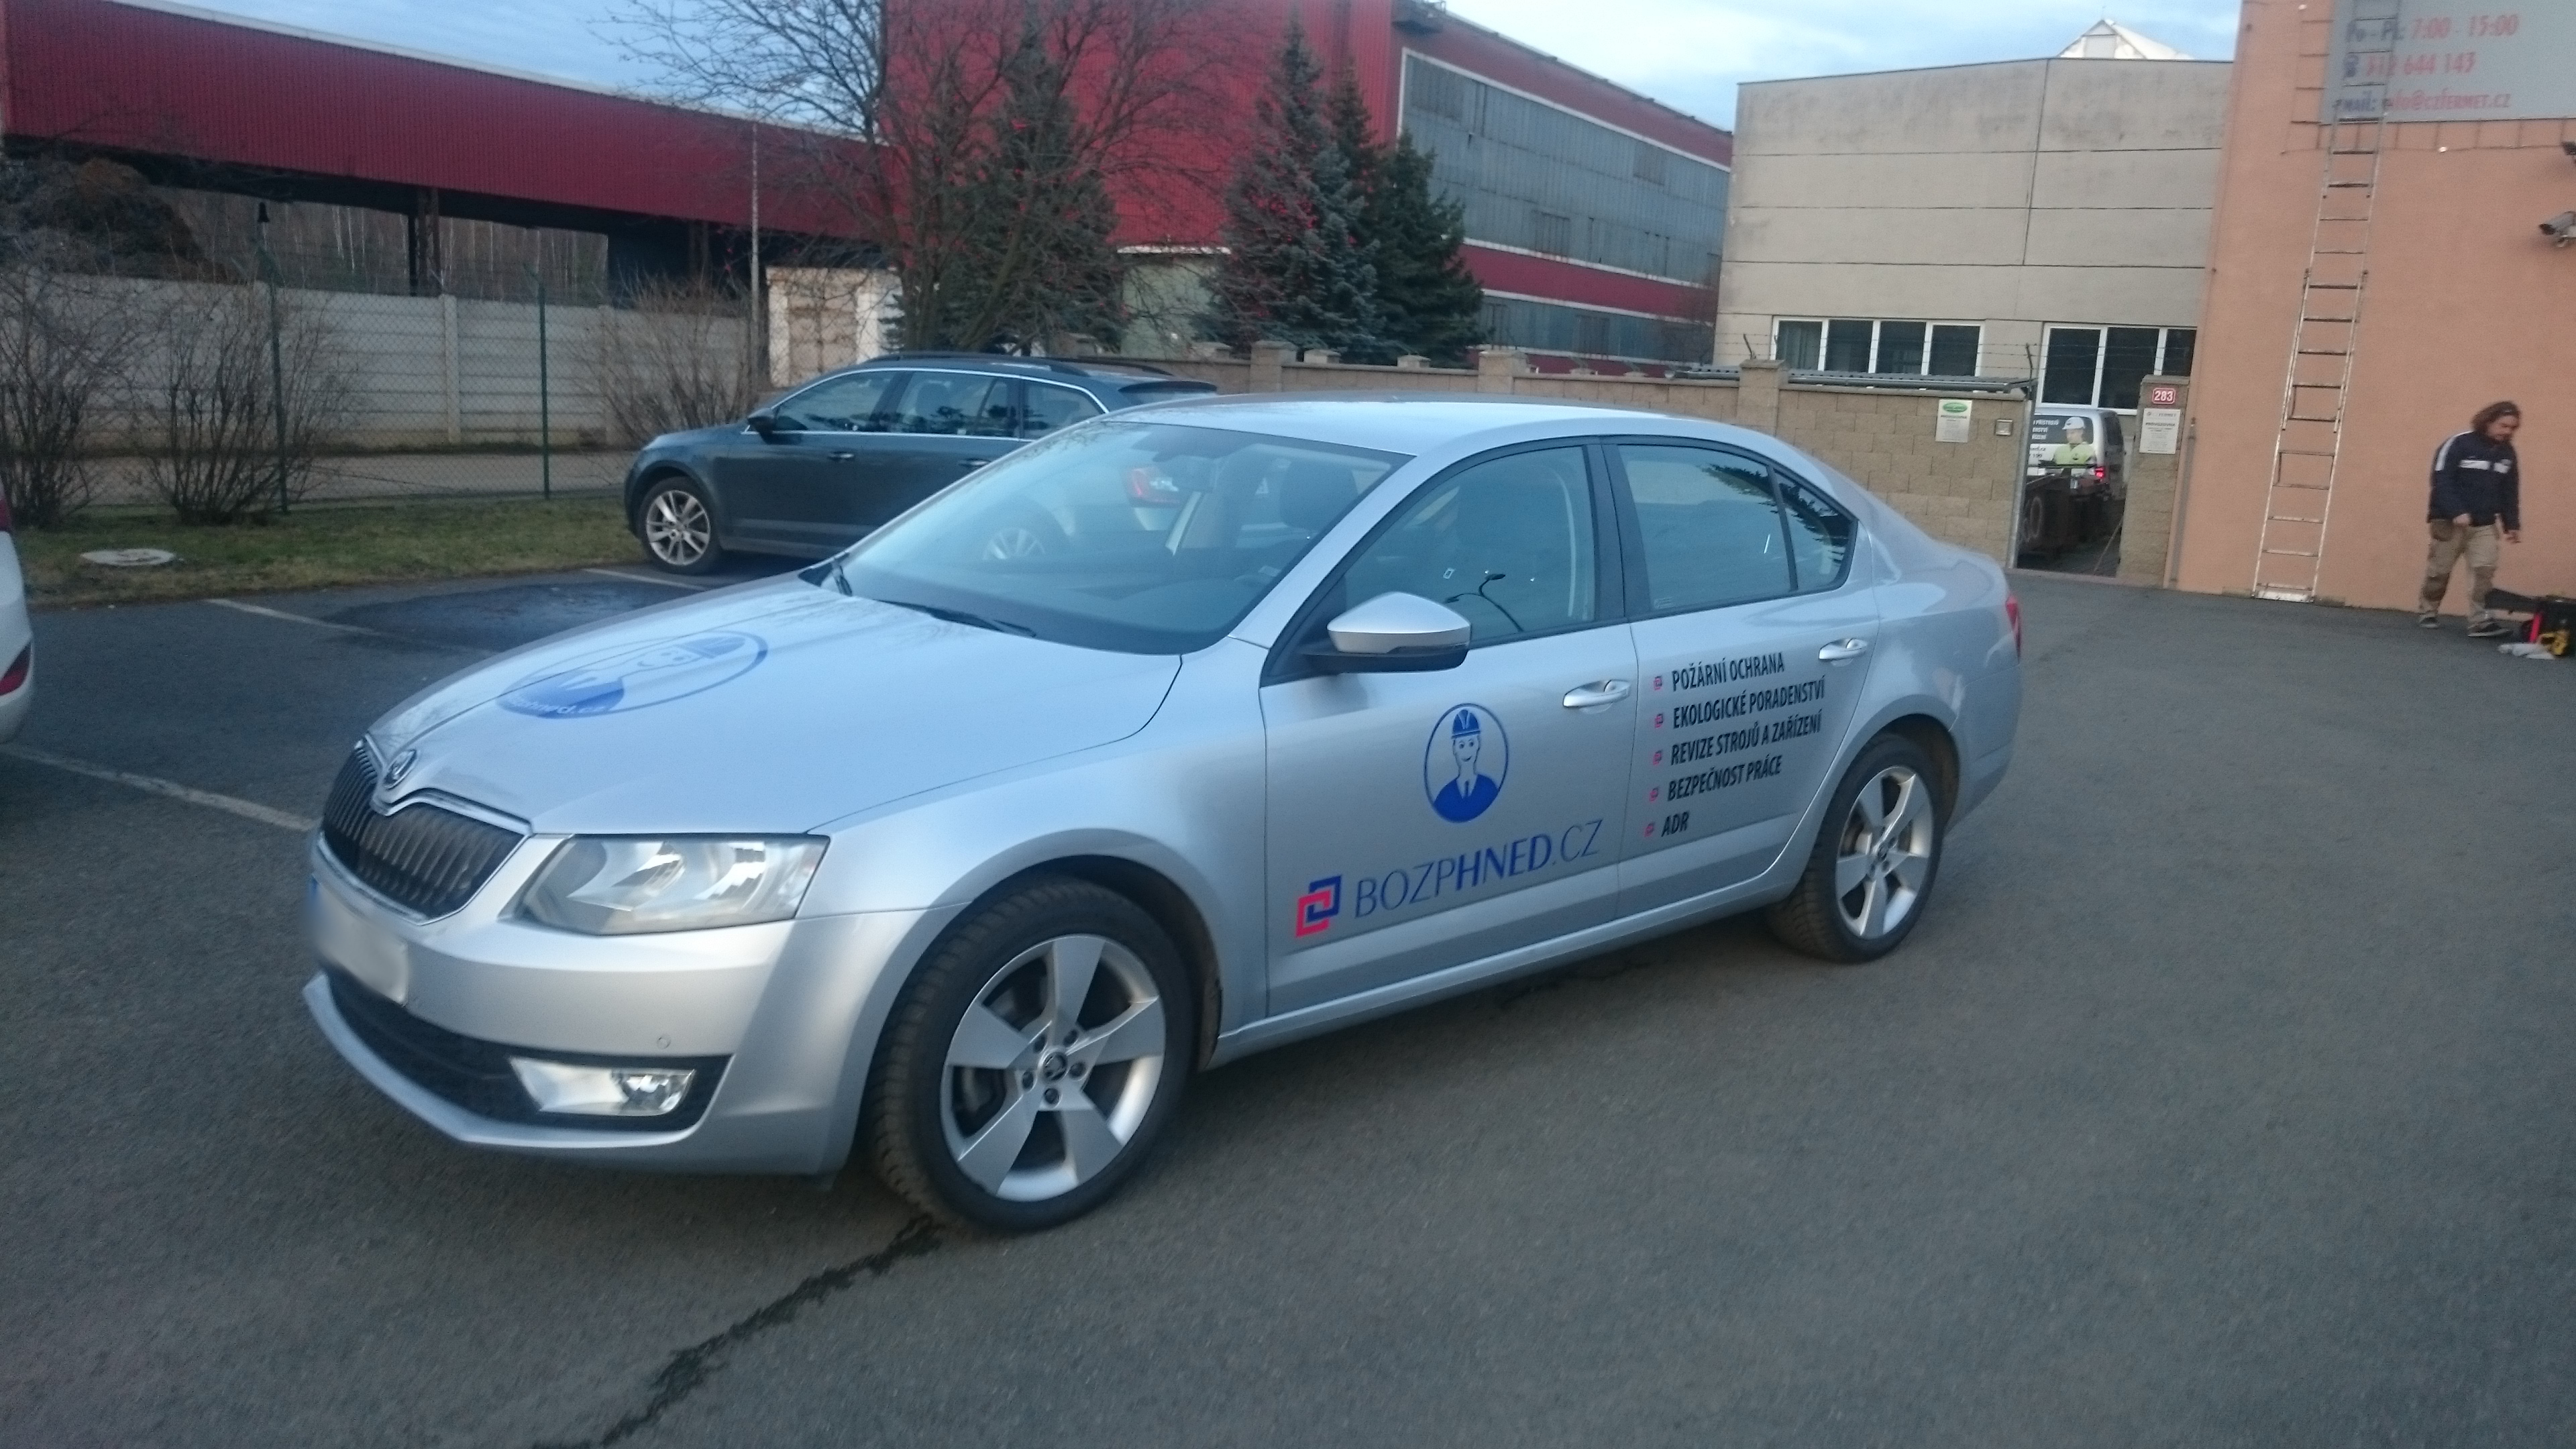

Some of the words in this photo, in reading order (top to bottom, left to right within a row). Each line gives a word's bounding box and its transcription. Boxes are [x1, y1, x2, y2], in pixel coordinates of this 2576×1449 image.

[2411, 17, 2452, 40] 7:00
[2468, 13, 2520, 37] 15:00
[2404, 53, 2436, 76] 644
[2154, 390, 2174, 402] 283
[1671, 657, 1727, 692] POŽÁRNÍ
[1729, 652, 1784, 681] OCHRANA
[1673, 690, 1746, 729] EKOLOGICKÉ
[1749, 674, 1825, 714] PORADENSTVÍ
[1670, 736, 1714, 765] REVIZE
[1715, 721, 1760, 755] STROJŮ
[1762, 725, 1770, 745] A
[1772, 709, 1822, 743] ZAŘÍZENÍ
[1667, 763, 1744, 802] BEZPEČNOST
[1746, 754, 1782, 782] PRÁCE
[1661, 810, 1690, 837] ADR
[1354, 818, 1604, 918] BOZPHNED.CZ
